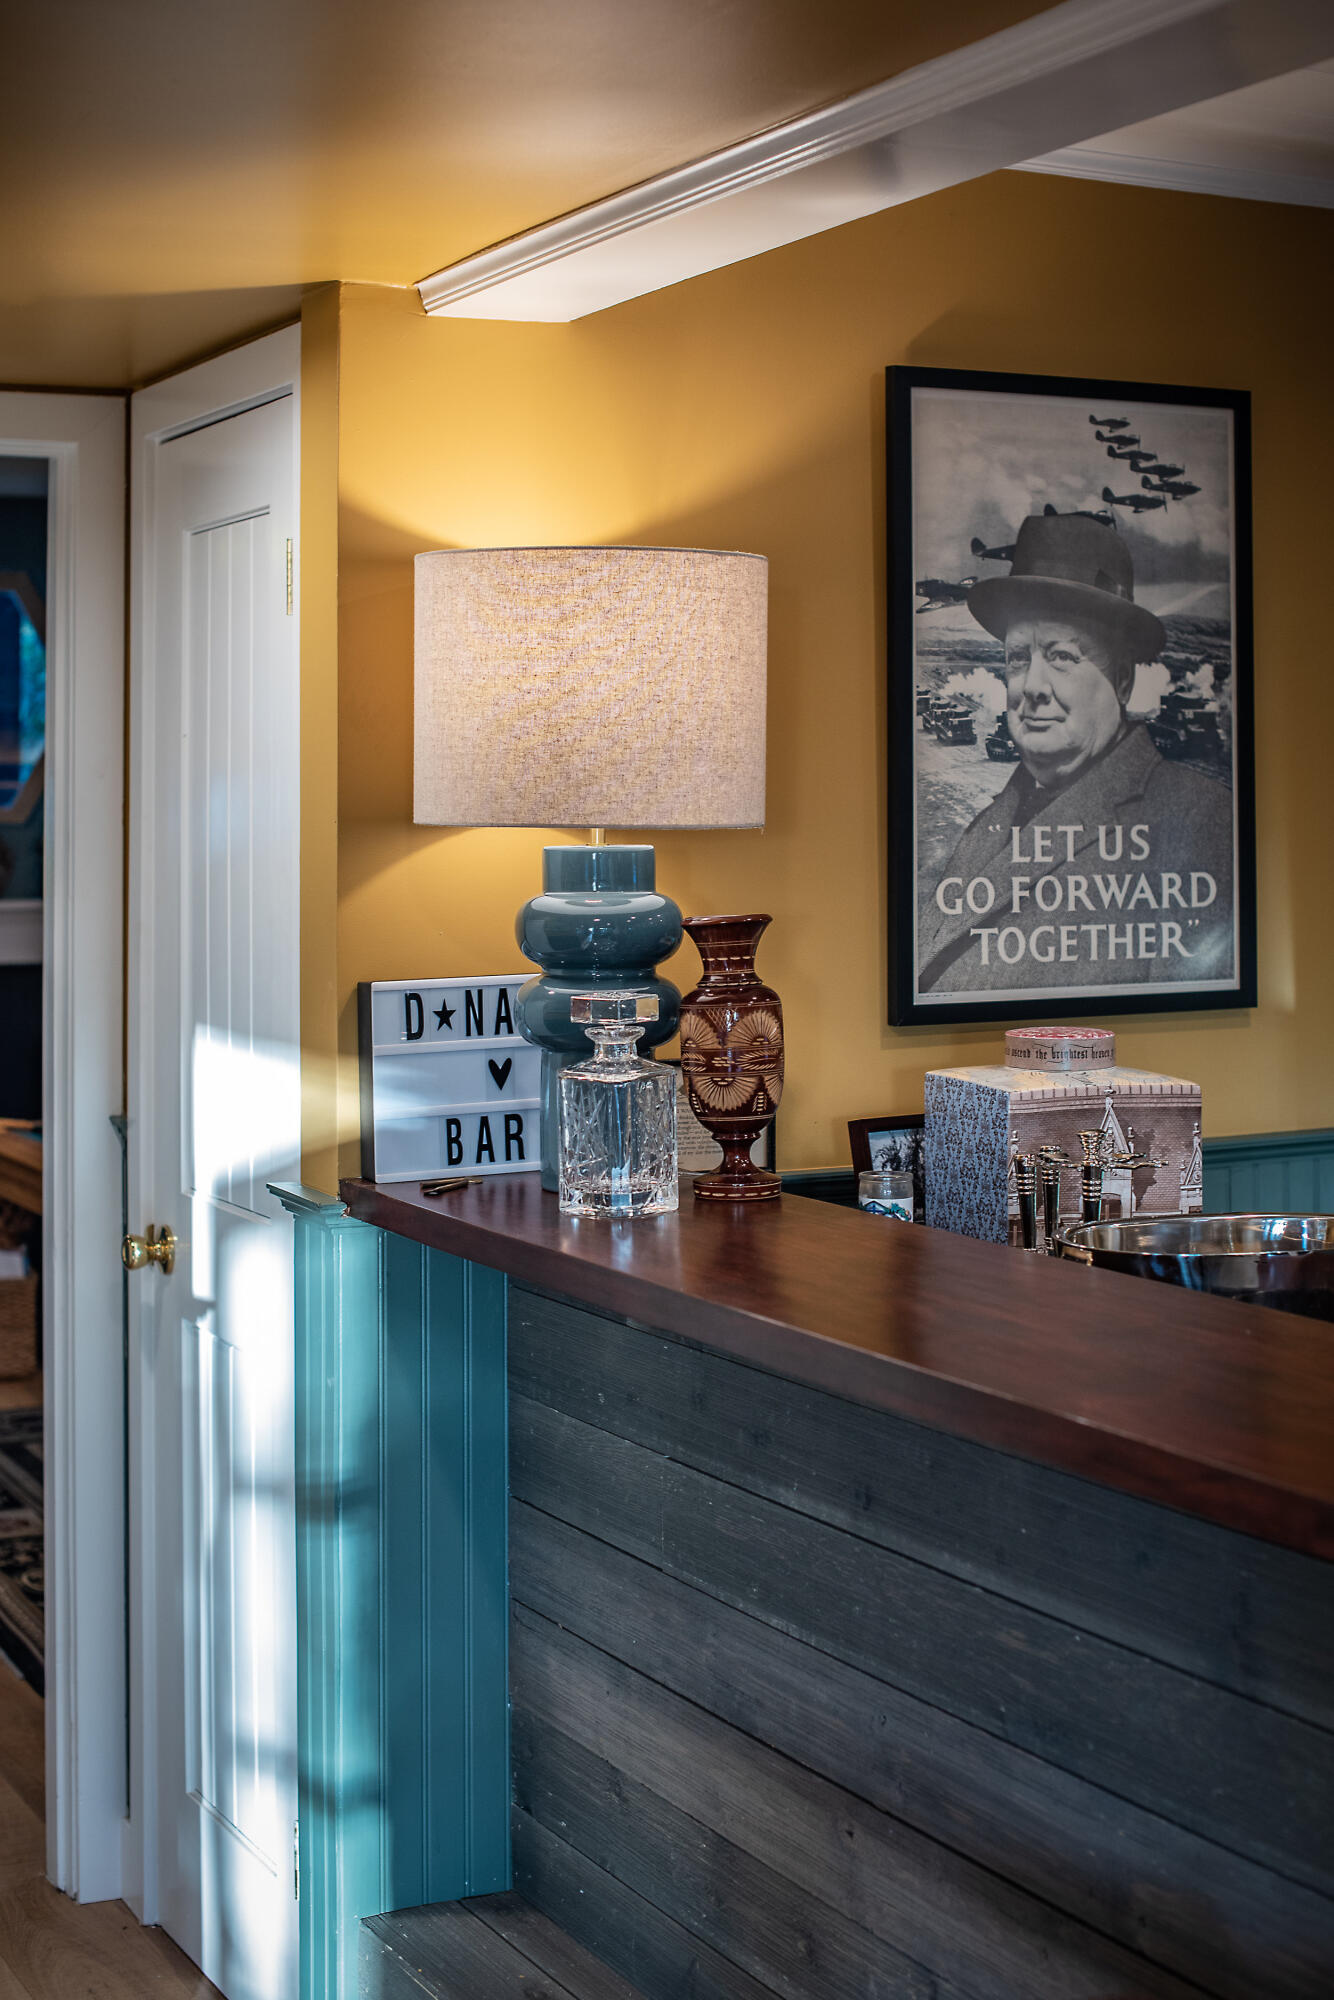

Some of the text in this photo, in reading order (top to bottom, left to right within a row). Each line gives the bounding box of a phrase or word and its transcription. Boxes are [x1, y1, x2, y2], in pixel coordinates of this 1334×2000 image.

[1099, 824, 1150, 862] US
[936, 872, 1217, 915] GO FORWARD
[1035, 1048, 1047, 1060] the
[446, 1113, 525, 1166] BAR
